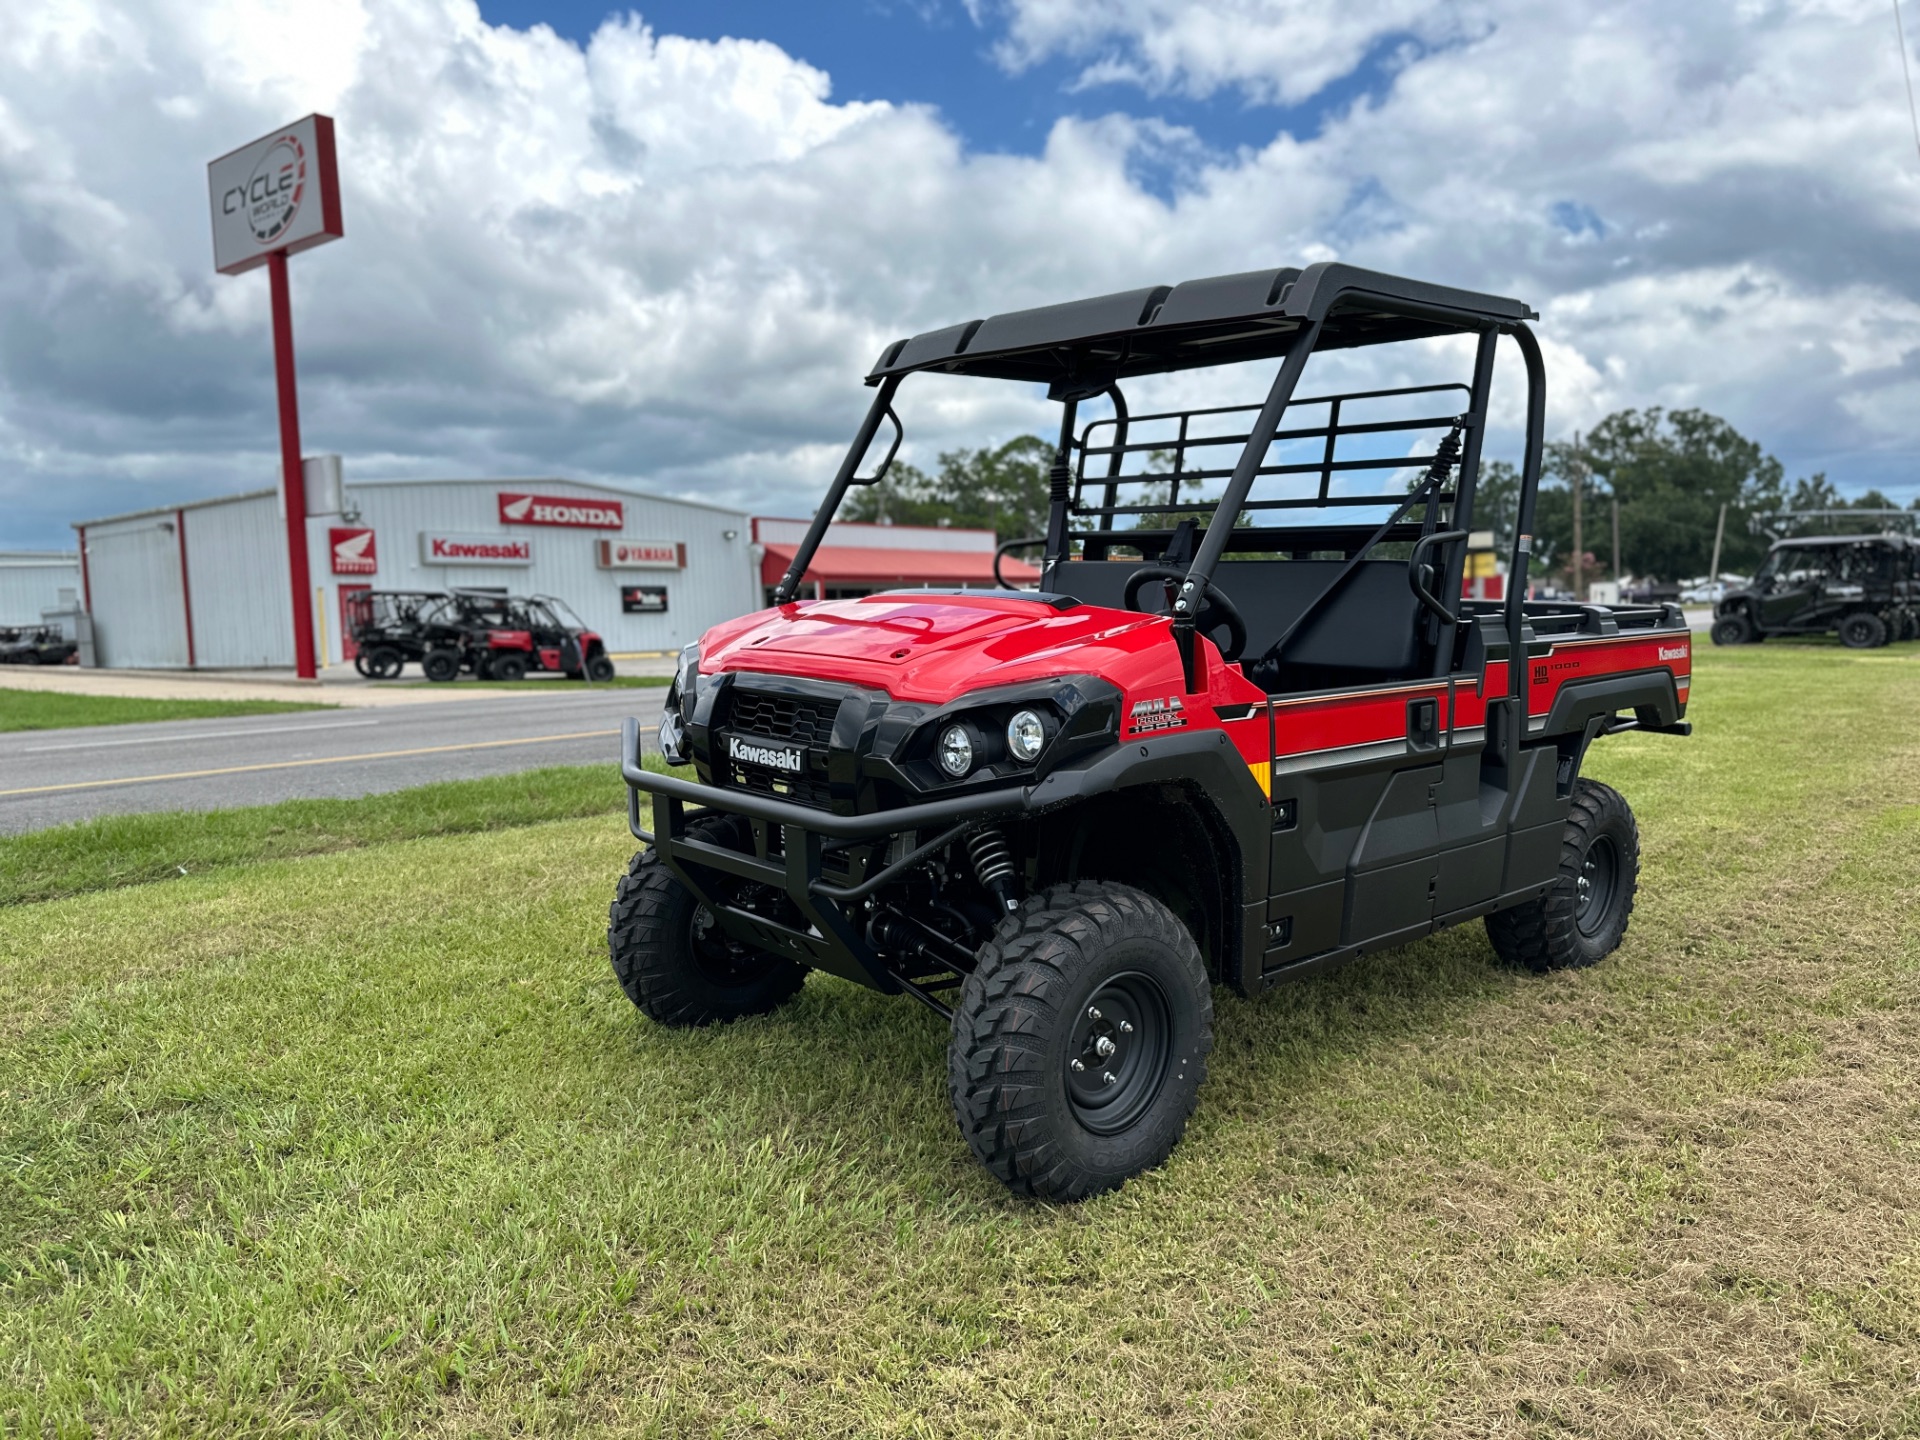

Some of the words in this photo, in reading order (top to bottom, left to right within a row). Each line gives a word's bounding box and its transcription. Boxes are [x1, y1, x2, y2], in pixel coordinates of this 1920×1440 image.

[222, 163, 294, 216] CYCLE
[532, 506, 622, 526] HONDA
[433, 539, 530, 561] Kawasaki
[630, 546, 675, 563] YAMAHA
[1658, 645, 1688, 661] Kawasaki
[1534, 665, 1547, 678] HD
[1550, 661, 1580, 670] 1000
[729, 737, 801, 771] Kawasaki
